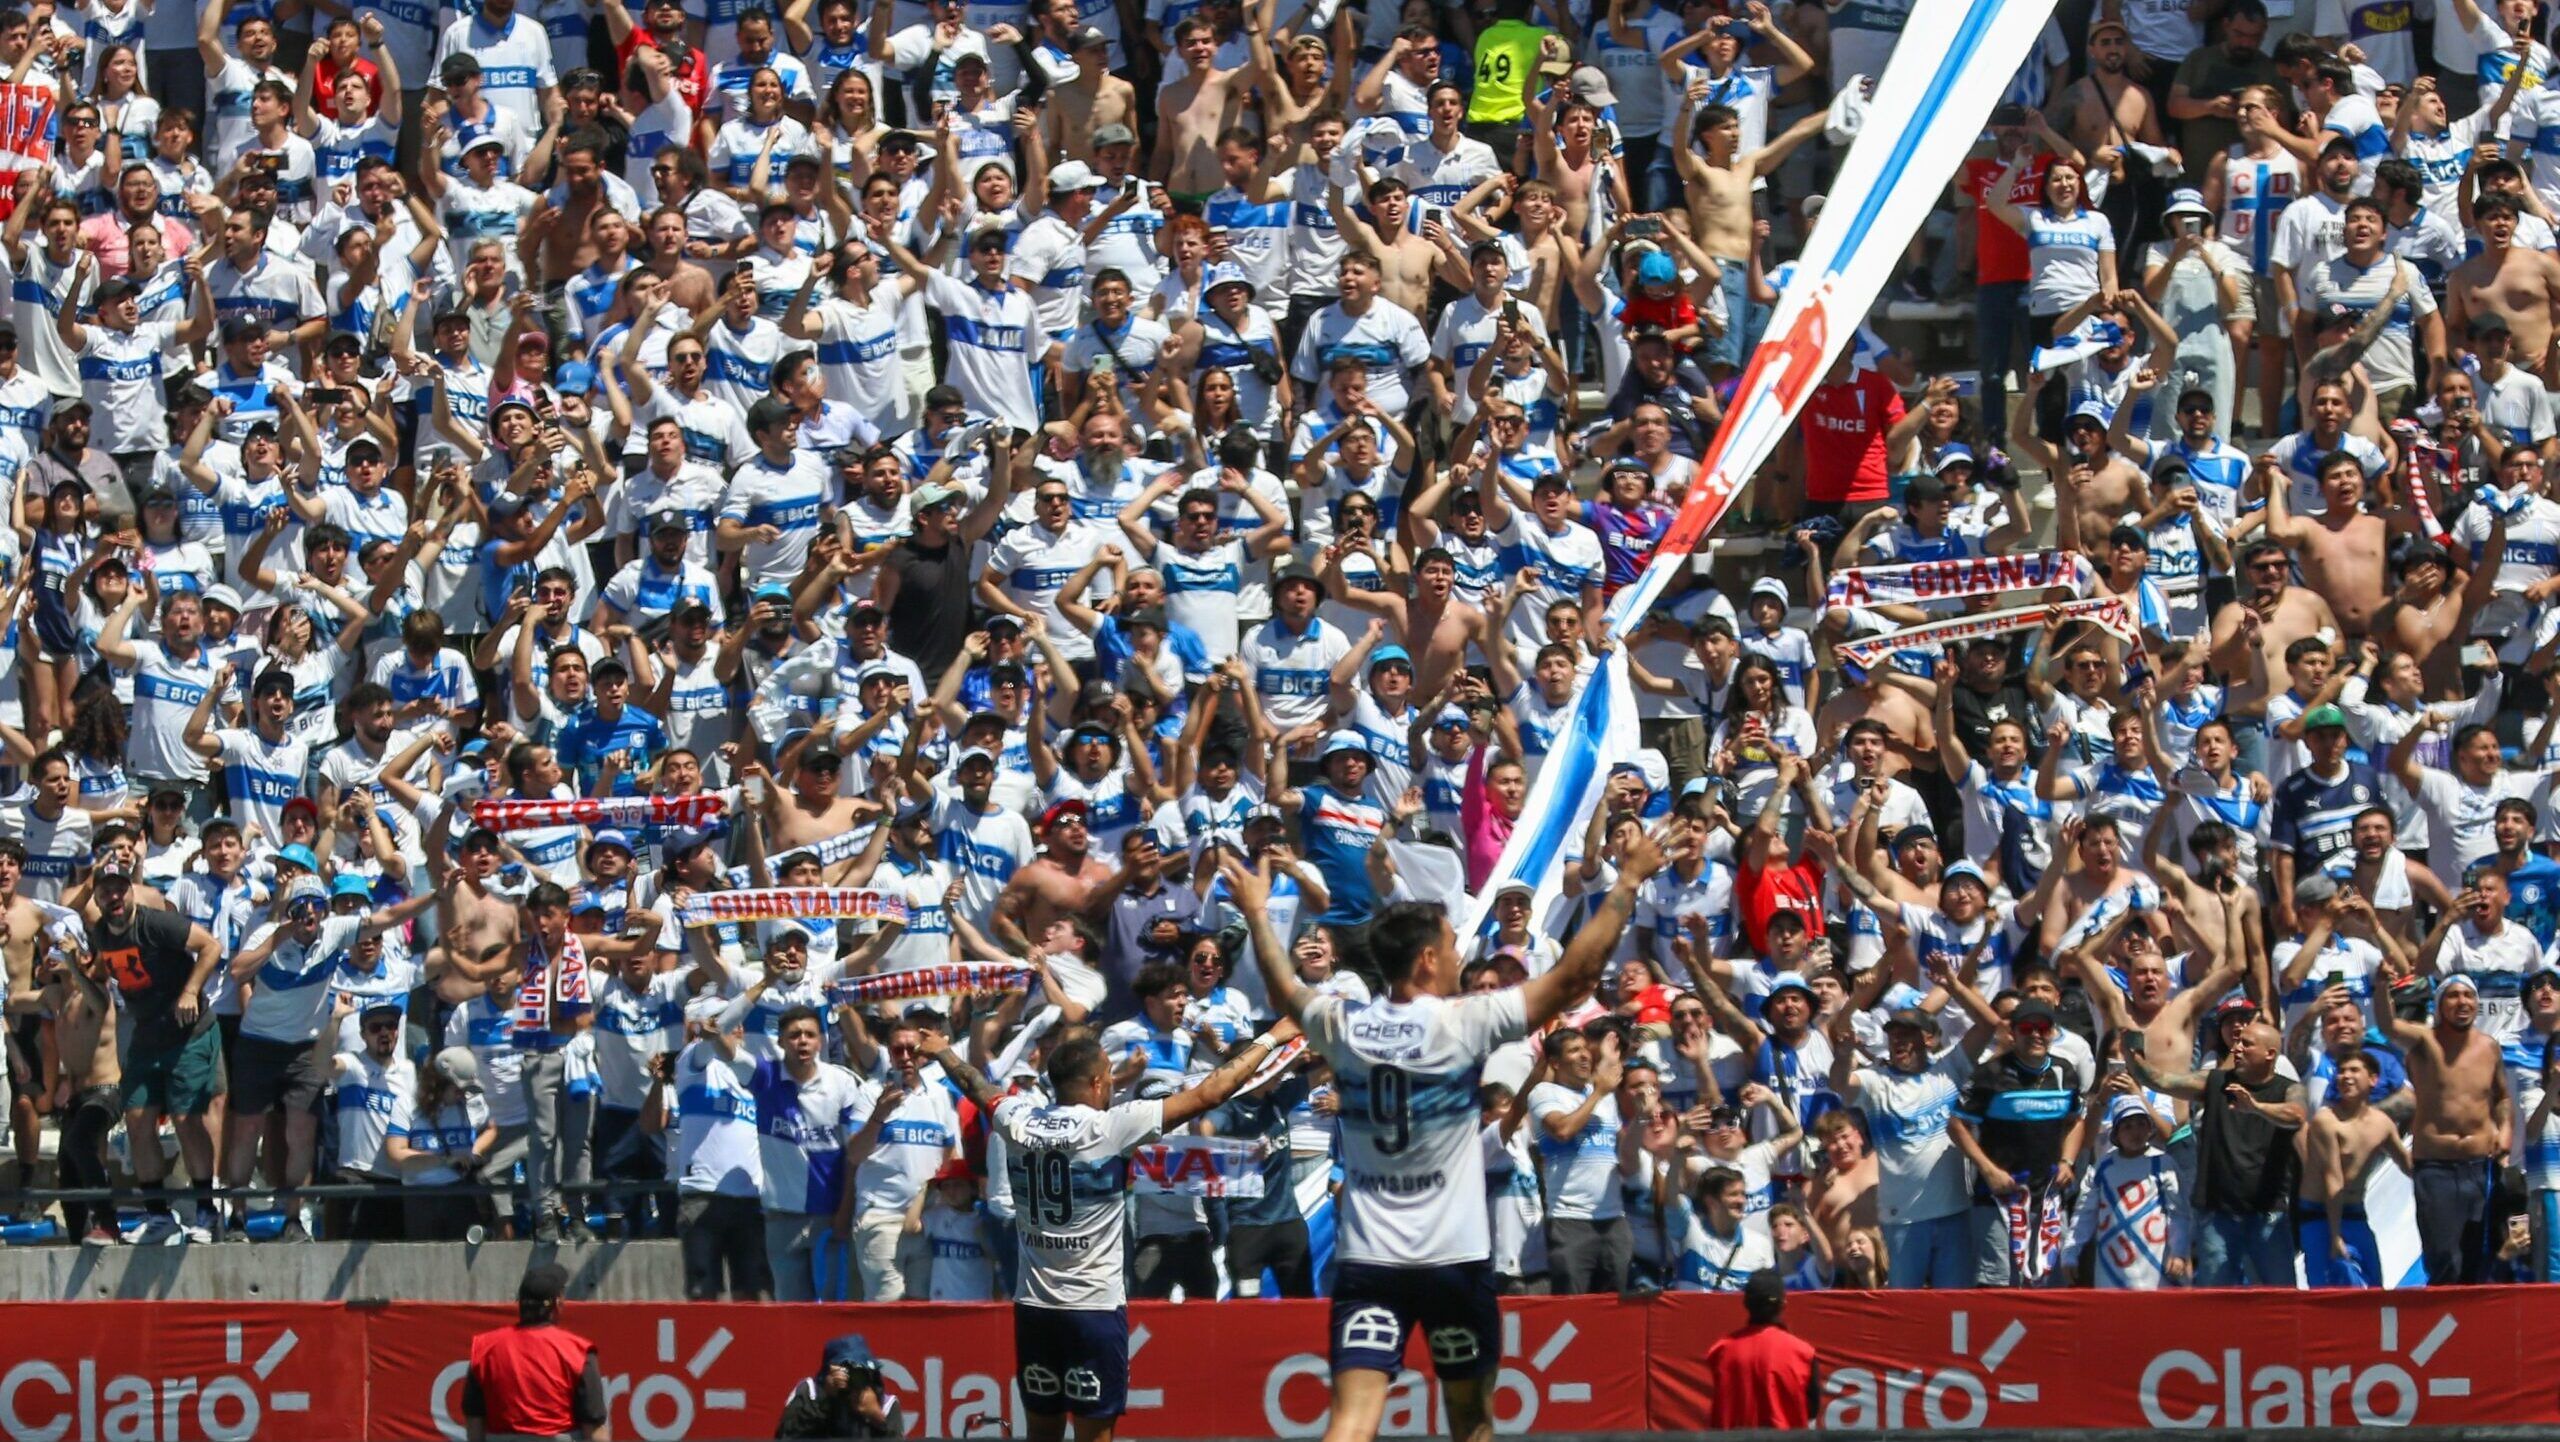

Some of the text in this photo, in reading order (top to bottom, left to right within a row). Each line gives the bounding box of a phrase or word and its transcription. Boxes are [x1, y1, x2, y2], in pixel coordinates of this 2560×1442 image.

[489, 69, 528, 86] BICE
[1478, 53, 1511, 84] 49
[459, 396, 488, 418] BIC
[1828, 418, 1866, 433] BICE
[187, 498, 219, 514] BIC
[2503, 549, 2537, 564] ICE
[158, 576, 184, 590] CE
[1912, 555, 2076, 598] GRANJA
[1282, 676, 1323, 694] BICE
[170, 686, 204, 704] BIC
[299, 714, 325, 732] BIC
[265, 781, 295, 799] BIC
[920, 910, 947, 928] BIC
[1352, 1023, 1426, 1041] CHERY
[1367, 1061, 1409, 1158] 9
[1026, 1116, 1082, 1131] CHERY
[1021, 1149, 1073, 1228] 19
[2139, 1347, 2419, 1430] Claro
[1, 1358, 260, 1442] Claro
[1810, 1366, 1989, 1430] aro
